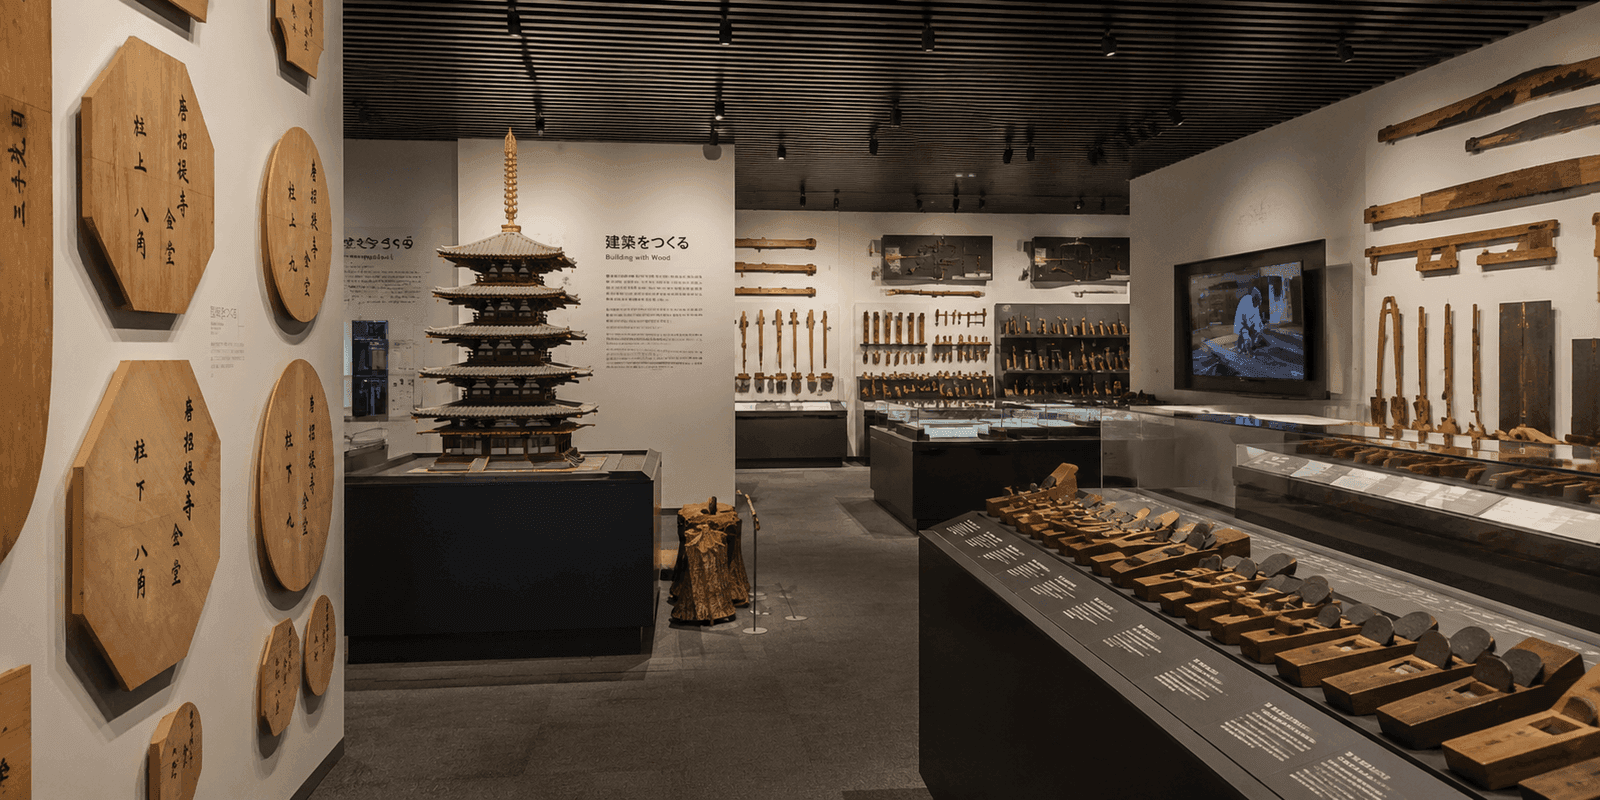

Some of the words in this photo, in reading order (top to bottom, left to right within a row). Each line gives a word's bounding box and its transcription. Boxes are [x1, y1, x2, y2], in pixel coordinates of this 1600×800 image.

[134, 207, 149, 260] 八角
[605, 235, 689, 250] 建築をつくる
[134, 438, 148, 502] 柱下
[134, 544, 148, 600] 八角
